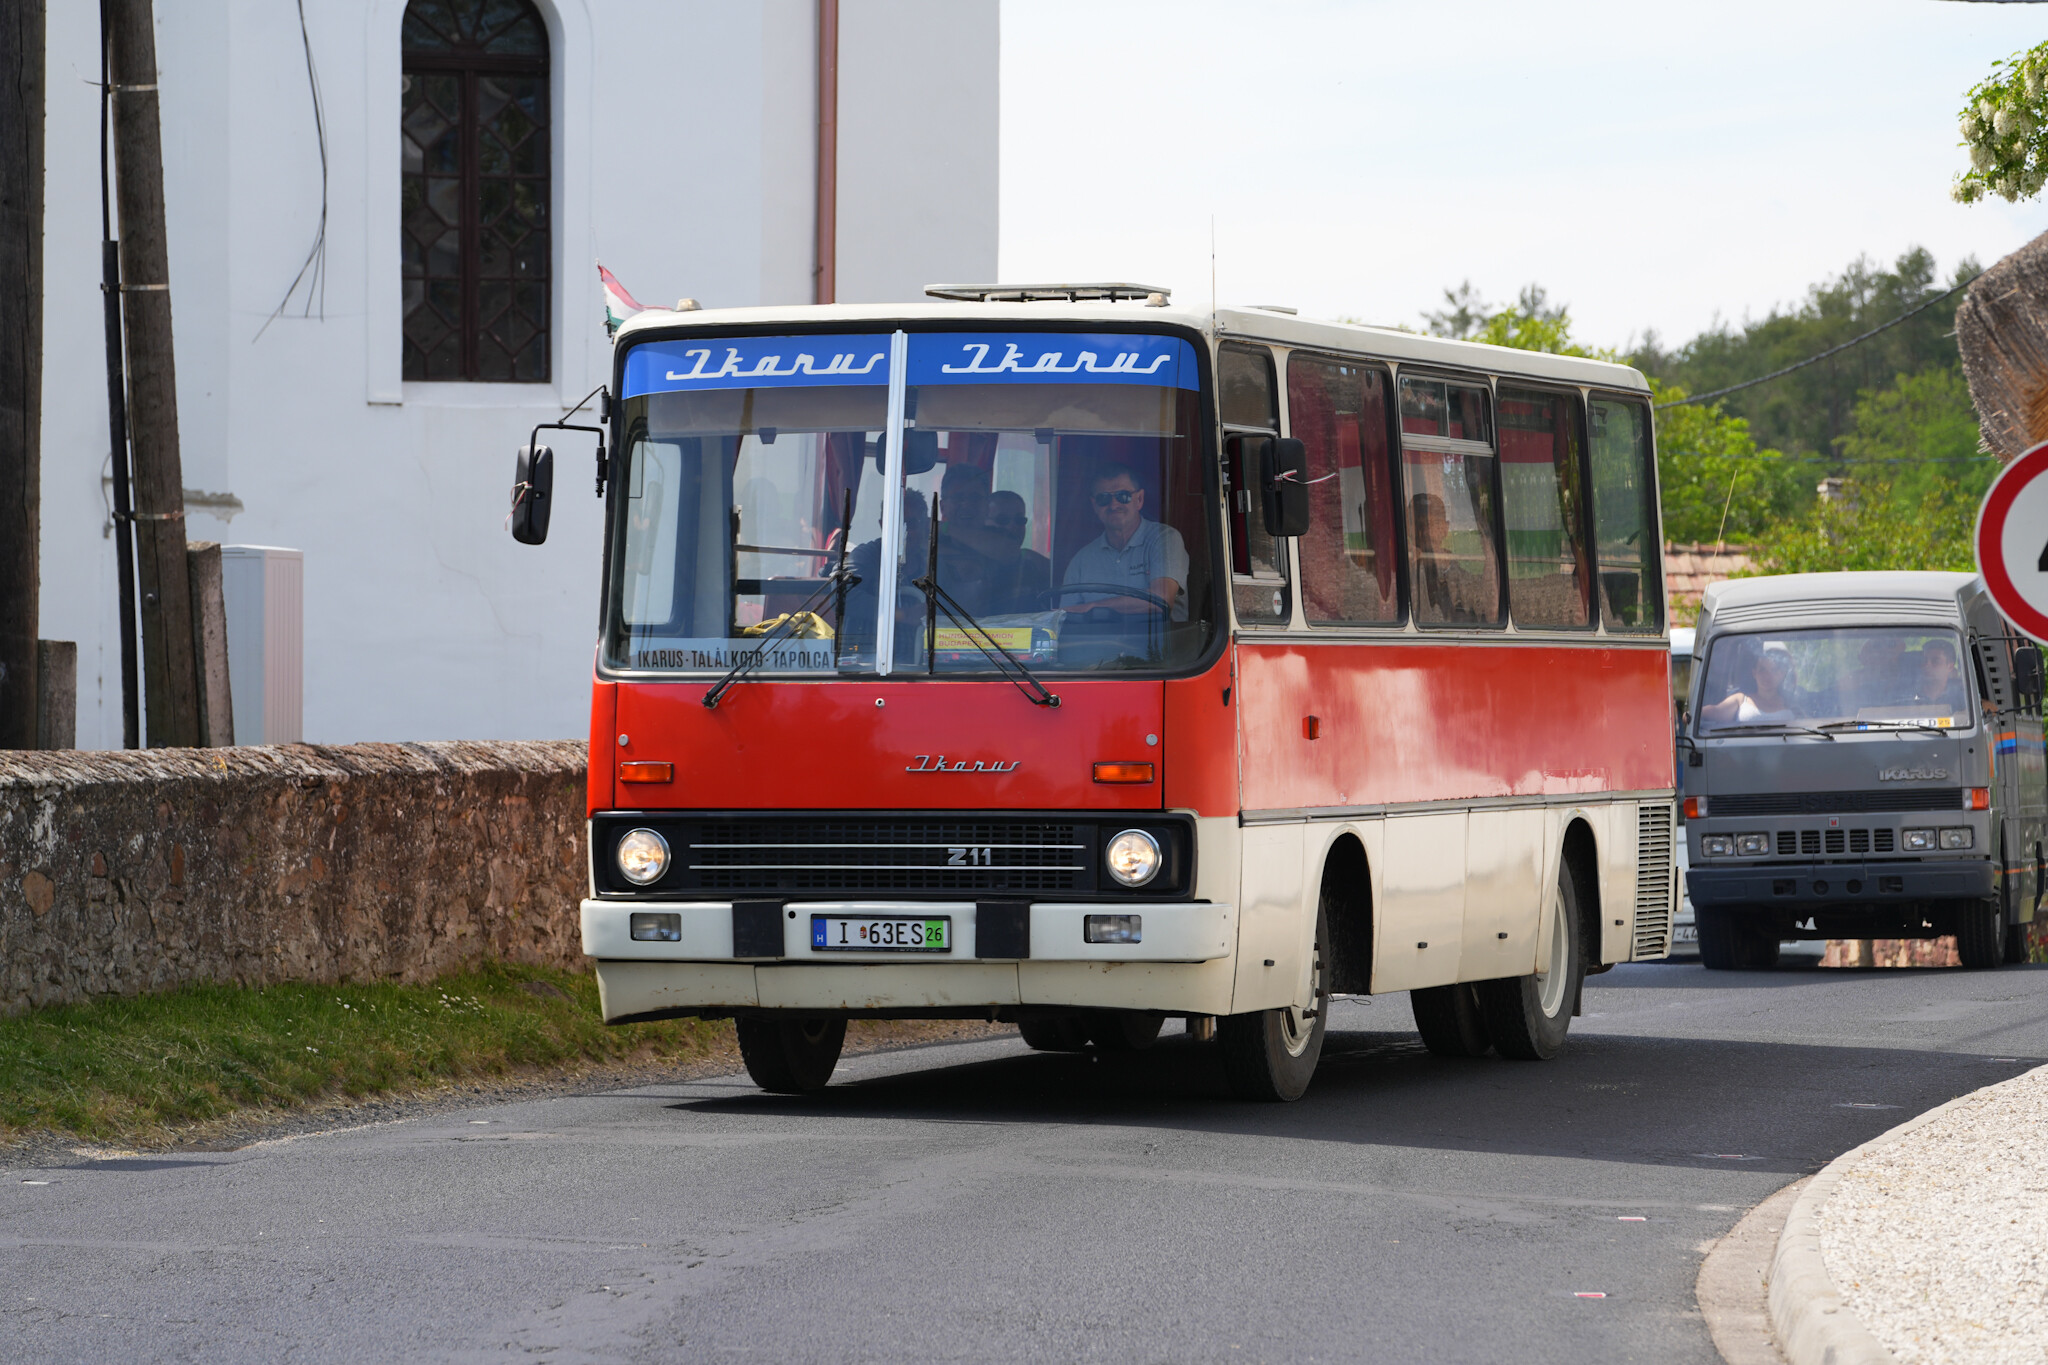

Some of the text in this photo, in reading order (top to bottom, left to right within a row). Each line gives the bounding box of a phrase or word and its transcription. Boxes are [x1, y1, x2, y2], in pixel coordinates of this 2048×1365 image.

[665, 347, 885, 381] Ikarus
[941, 343, 1171, 374] Ikarus
[638, 650, 684, 668] IKARUS
[772, 650, 830, 669] TAPOLCA
[905, 754, 1021, 772] Ikarus
[1878, 768, 1948, 781] IKARUS
[947, 847, 992, 866] Z11
[869, 922, 923, 945] 63ES
[926, 927, 942, 941] 26
